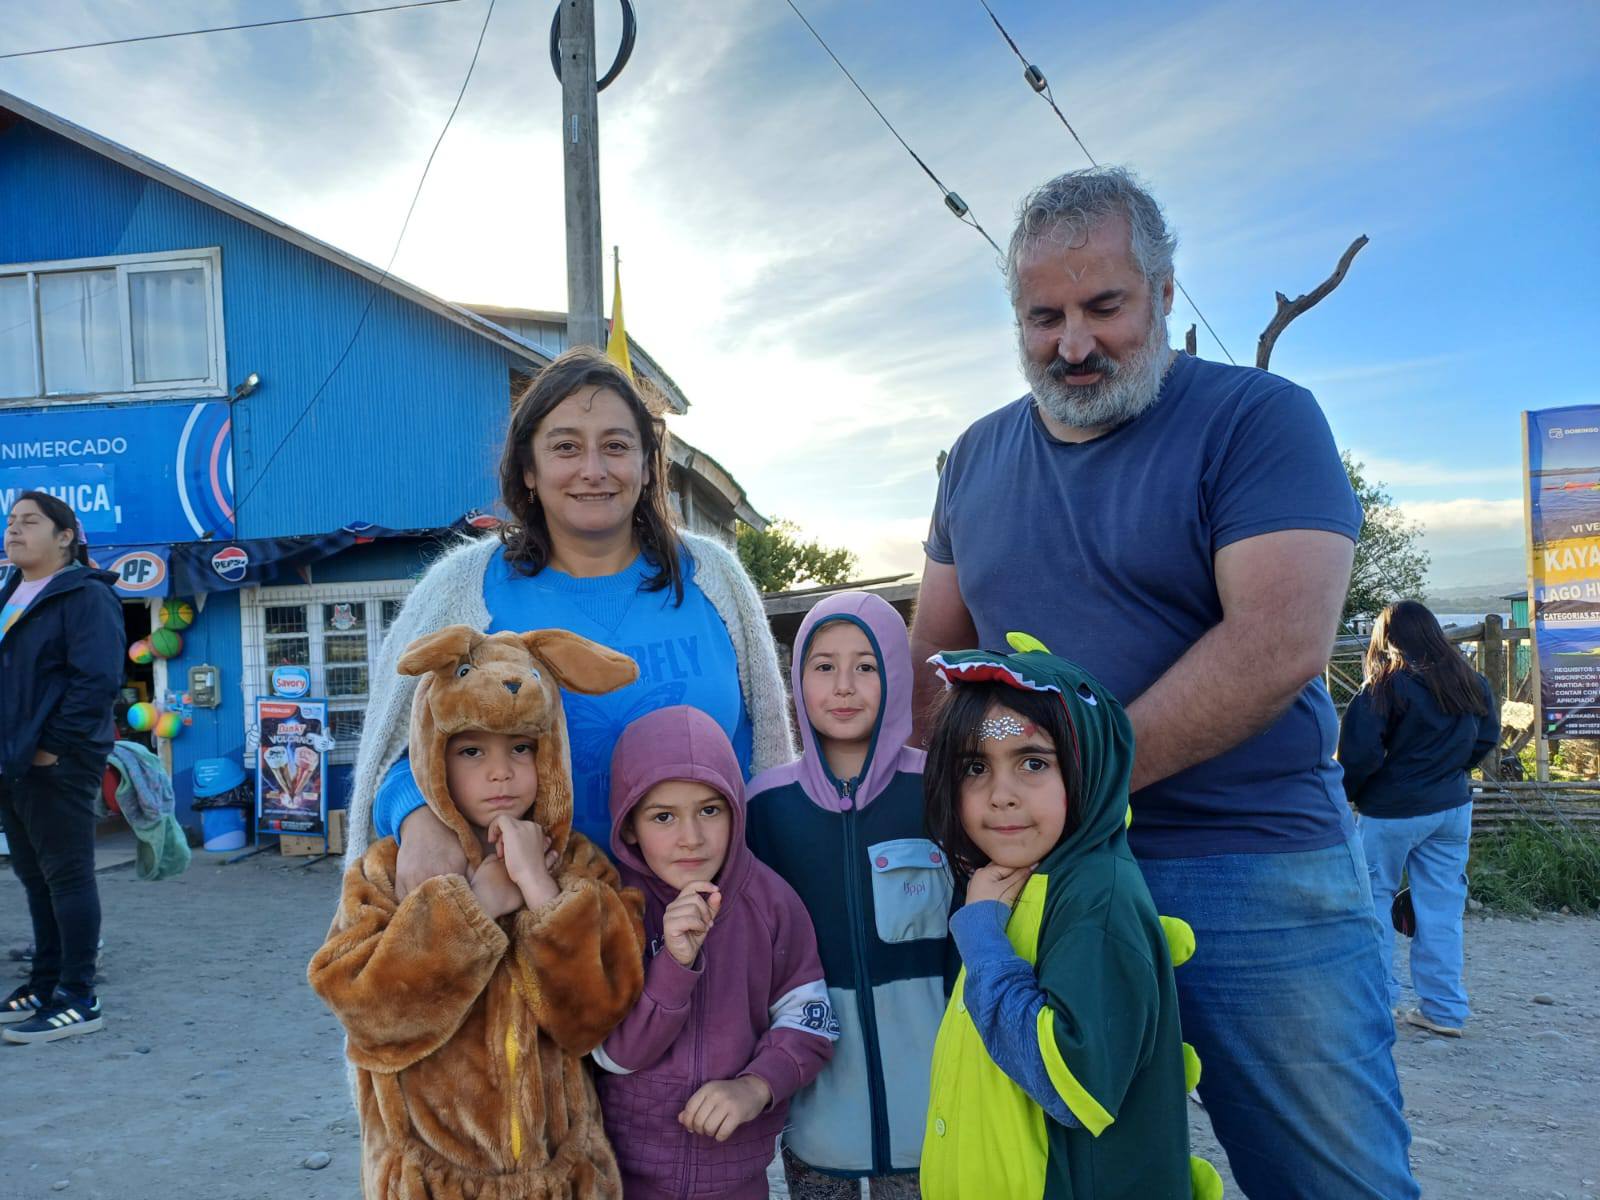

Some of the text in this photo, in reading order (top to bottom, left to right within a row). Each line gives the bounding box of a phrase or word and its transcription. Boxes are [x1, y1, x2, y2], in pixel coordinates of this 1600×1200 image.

[33, 483, 110, 513] HICA
[1571, 524, 1583, 534] VI
[123, 559, 152, 583] PF
[214, 559, 245, 569] PEPSI
[1540, 585, 1581, 603] LAGO
[277, 678, 305, 689] Savory
